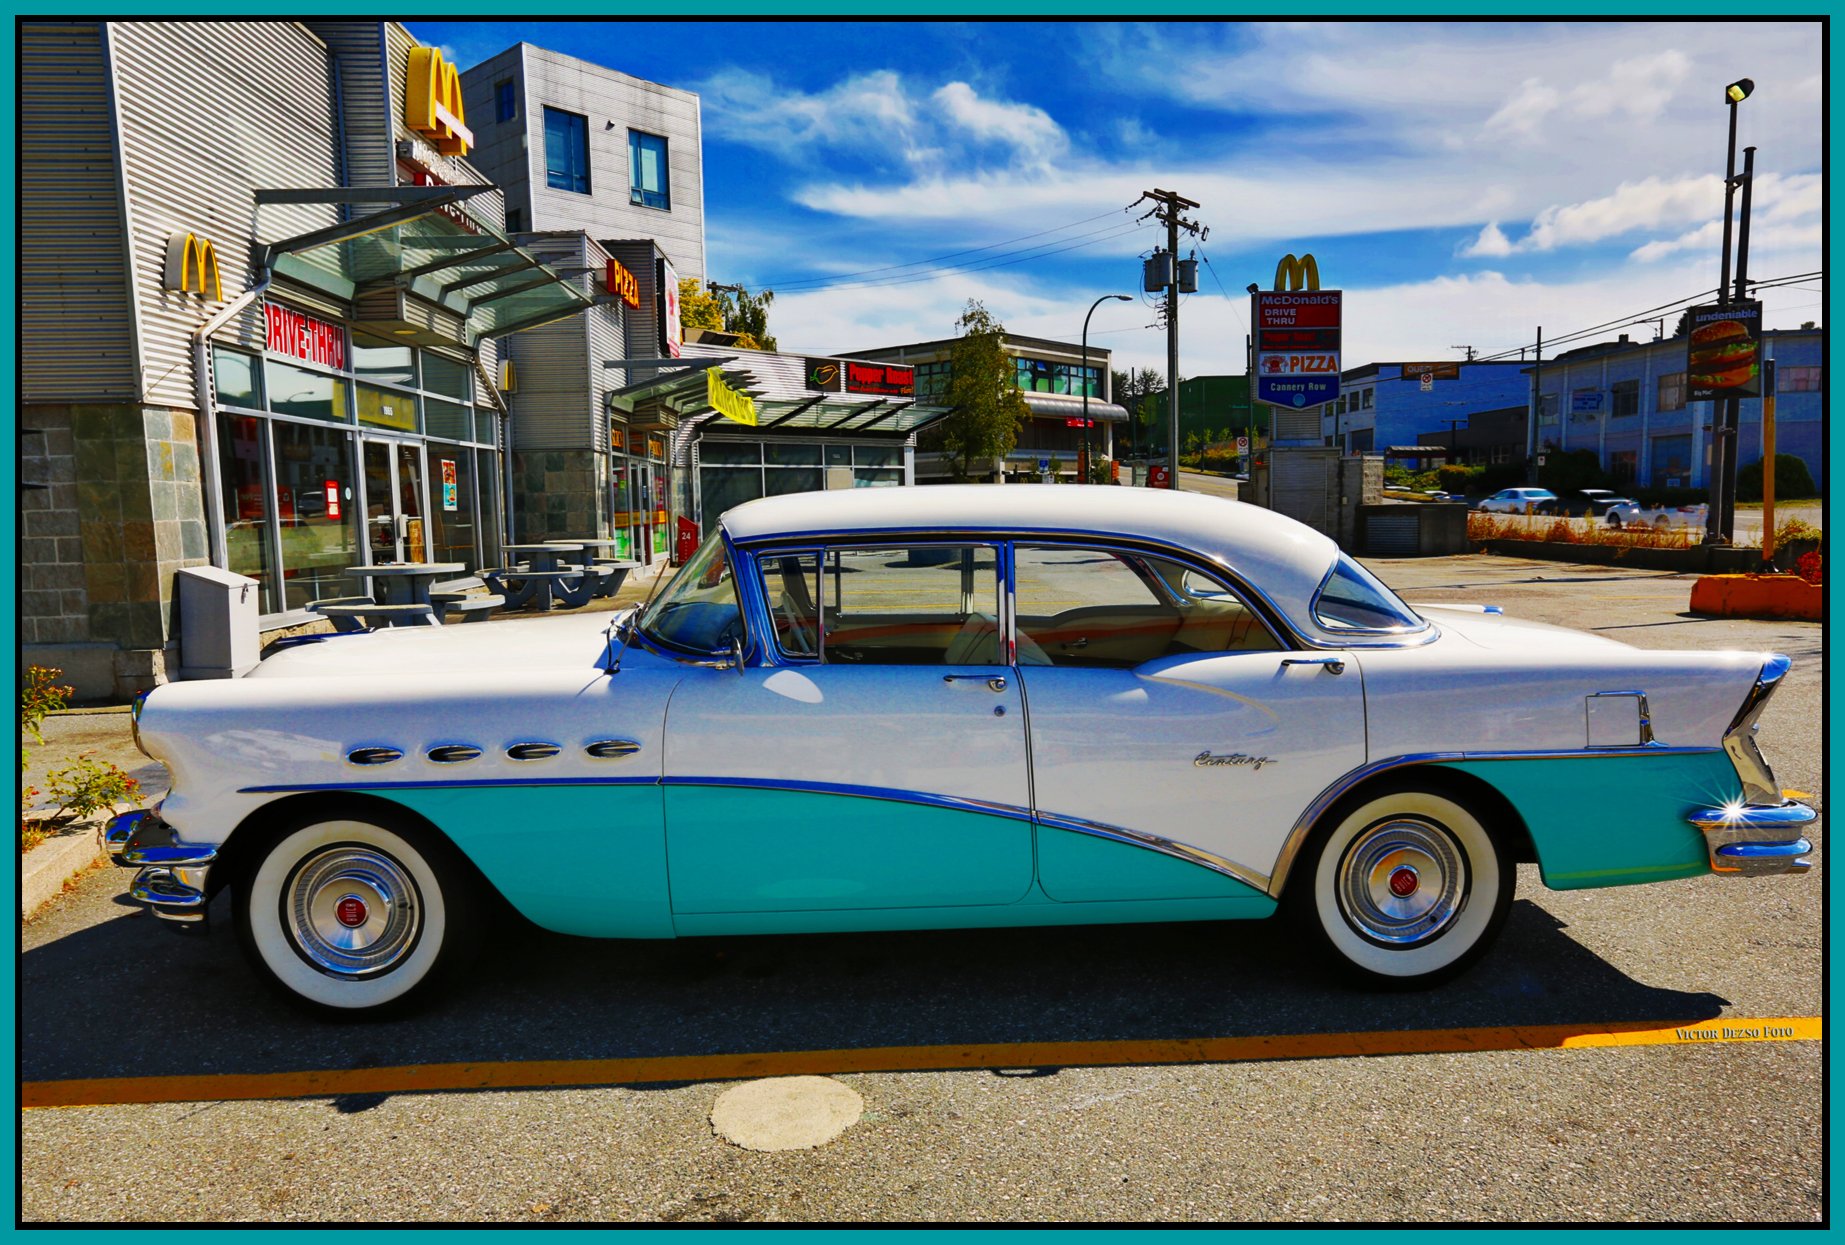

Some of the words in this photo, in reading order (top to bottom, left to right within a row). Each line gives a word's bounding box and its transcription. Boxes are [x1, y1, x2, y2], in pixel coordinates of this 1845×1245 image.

[614, 259, 640, 310] PIZZA
[1261, 295, 1338, 305] McDonald's
[1264, 308, 1297, 316] DRIVE
[1695, 309, 1758, 322] undeniable
[1266, 317, 1296, 325] THRU
[1289, 354, 1338, 373] PIZZA
[1270, 382, 1305, 392] Cannery
[1308, 382, 1326, 391] Row
[681, 531, 691, 540] 24
[1193, 750, 1279, 771] Century
